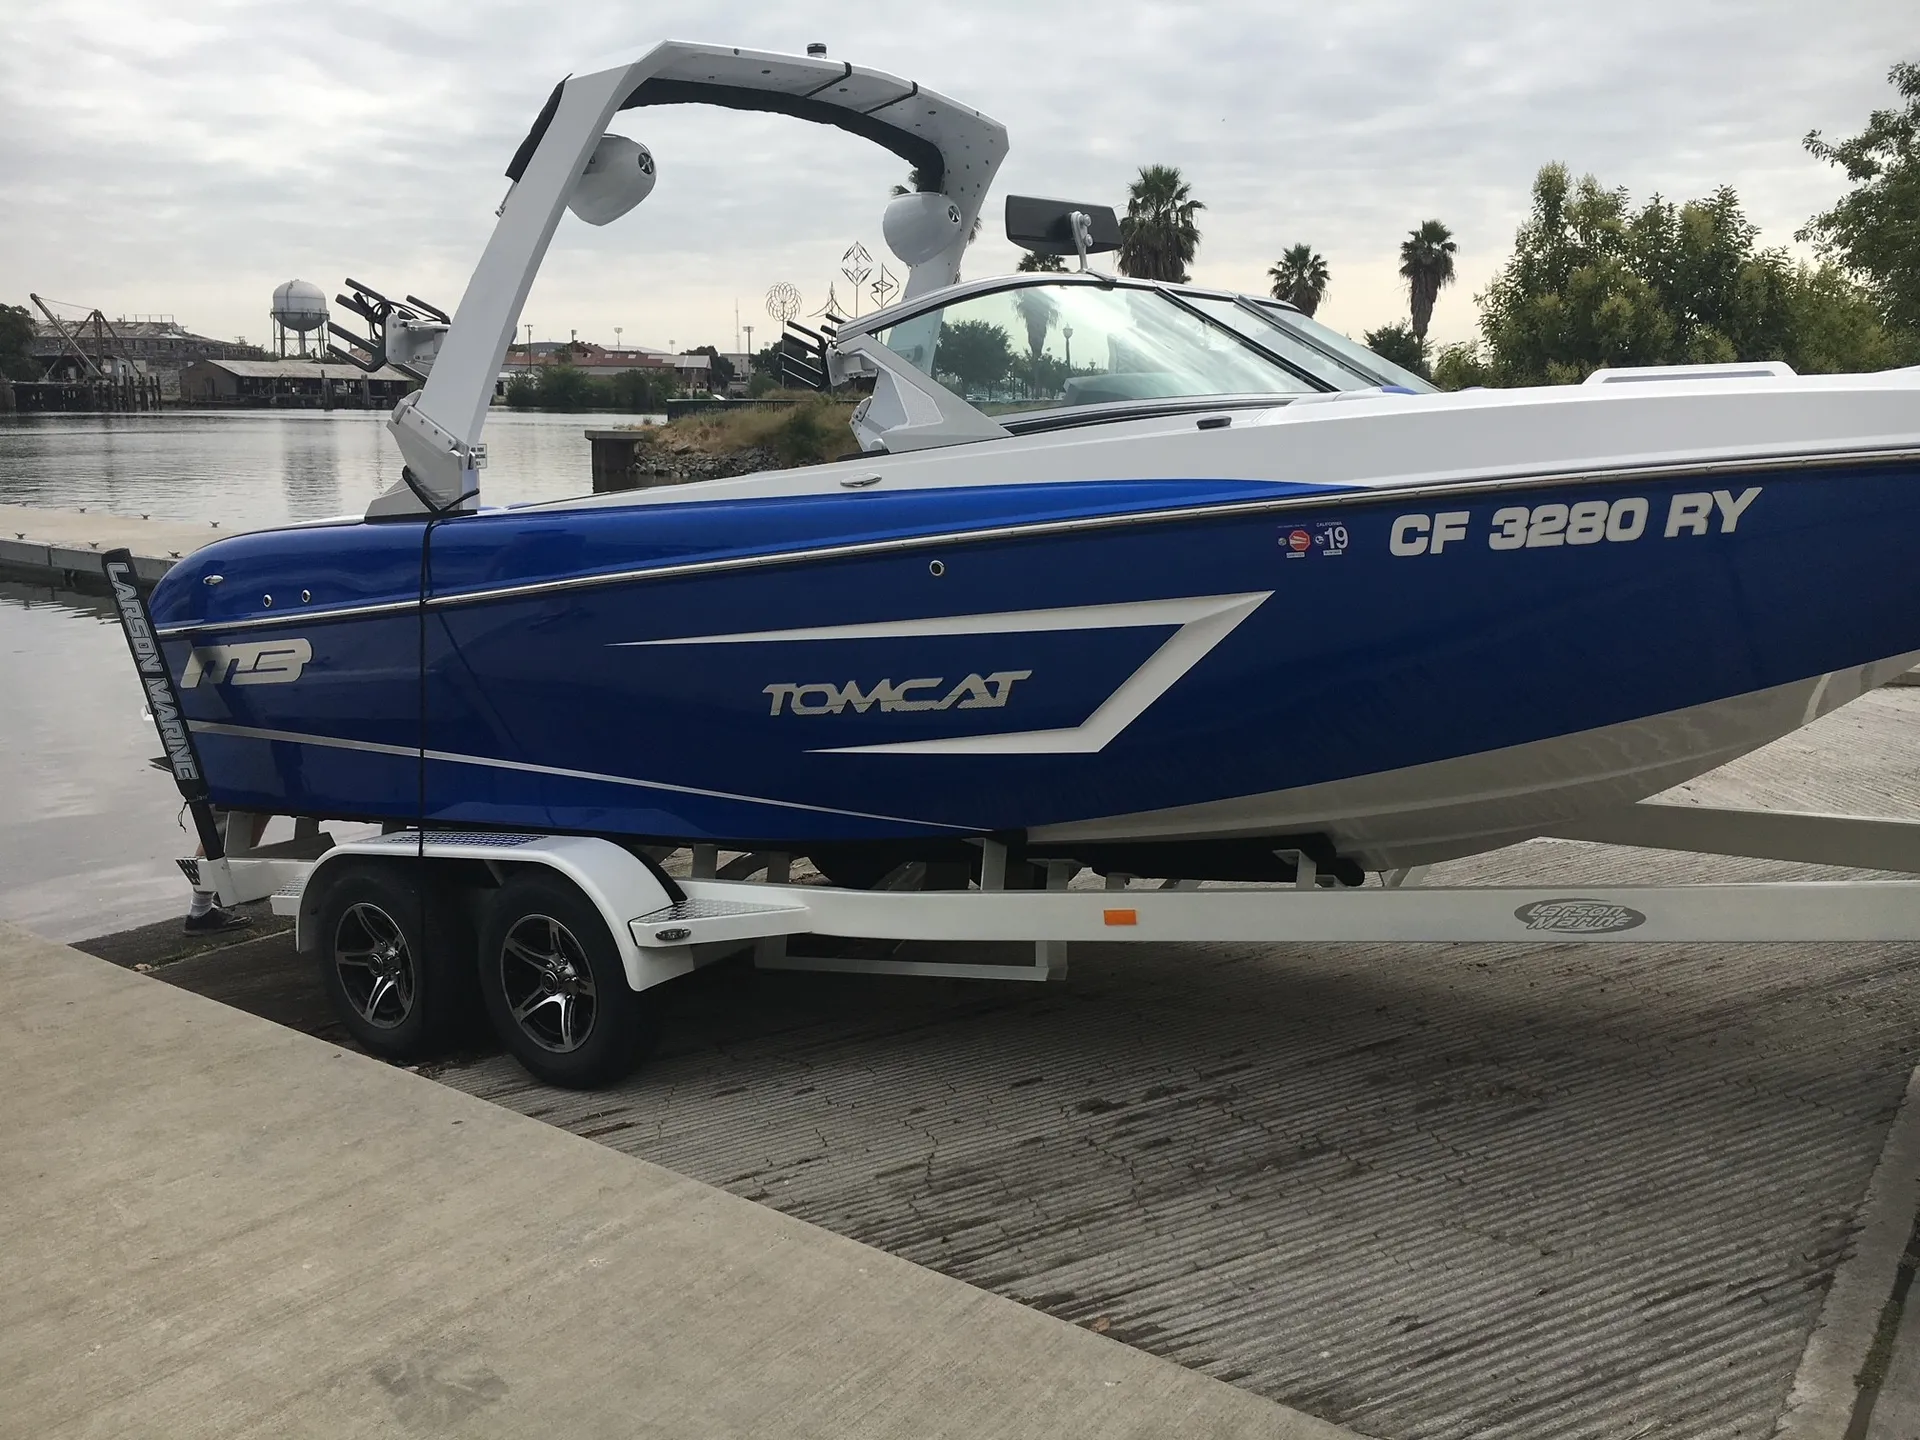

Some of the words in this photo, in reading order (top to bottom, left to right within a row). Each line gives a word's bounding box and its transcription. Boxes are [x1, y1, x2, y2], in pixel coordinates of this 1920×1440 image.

[1324, 526, 1349, 549] 19
[1388, 511, 1471, 557] CF
[1488, 496, 1650, 551] 3280
[1664, 486, 1764, 539] RY
[106, 562, 164, 673] LARSON
[144, 677, 200, 781] MARINE
[761, 669, 1033, 716] TOMCAT
